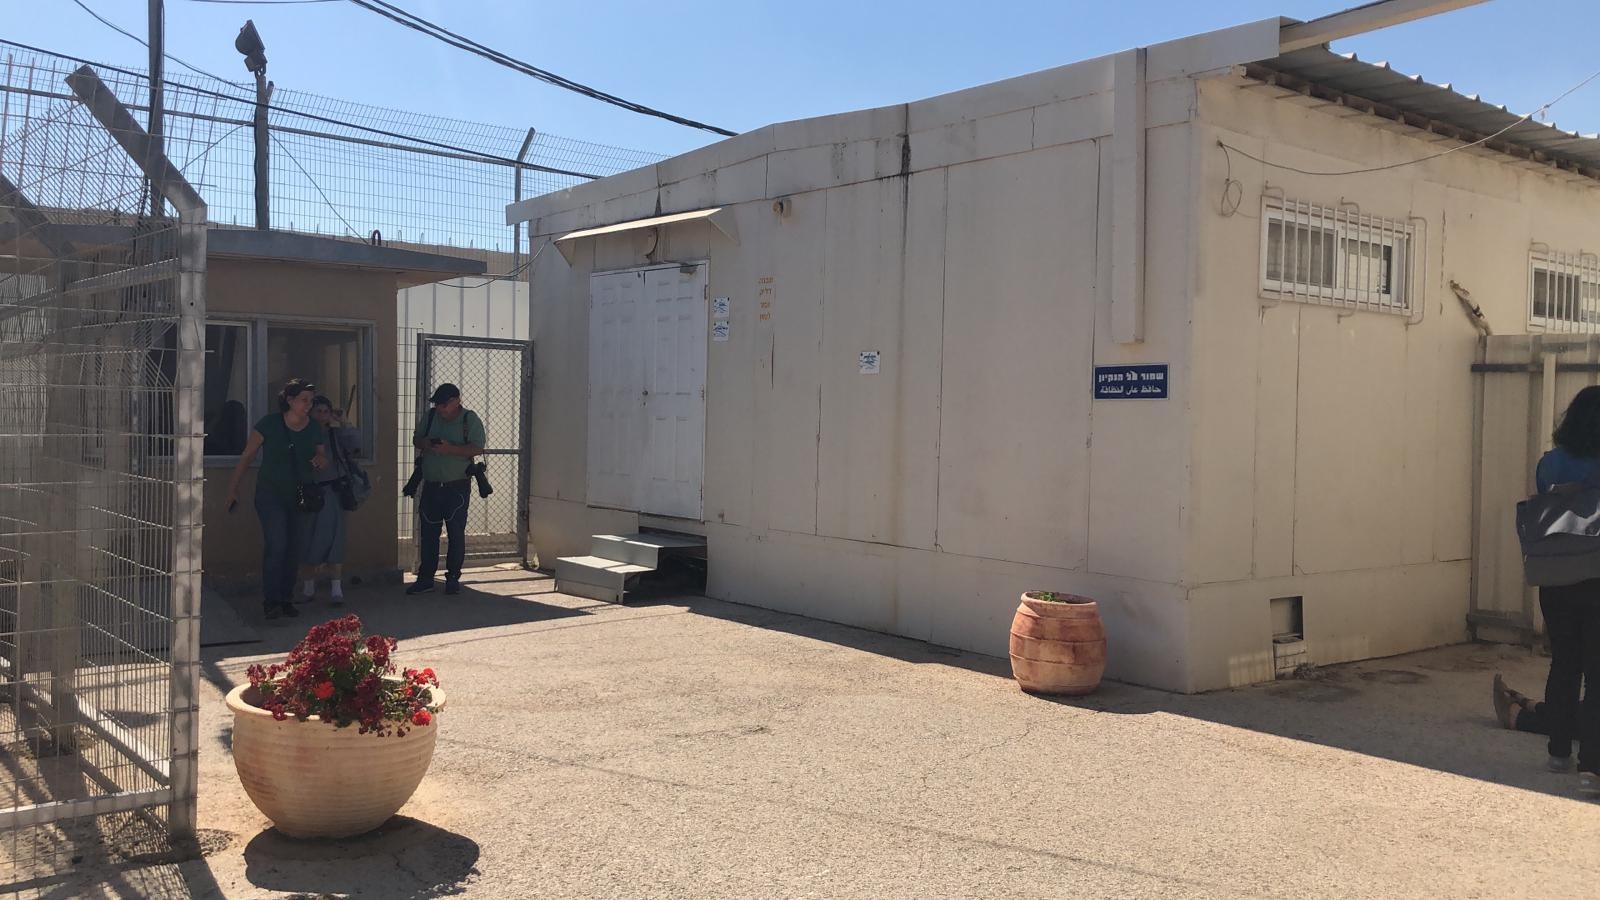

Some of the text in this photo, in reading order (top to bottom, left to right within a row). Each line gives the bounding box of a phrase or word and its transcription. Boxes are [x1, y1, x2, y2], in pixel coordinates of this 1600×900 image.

[1098, 370, 1164, 383] שמור על הנקיון
[1141, 385, 1162, 393] حافظ
